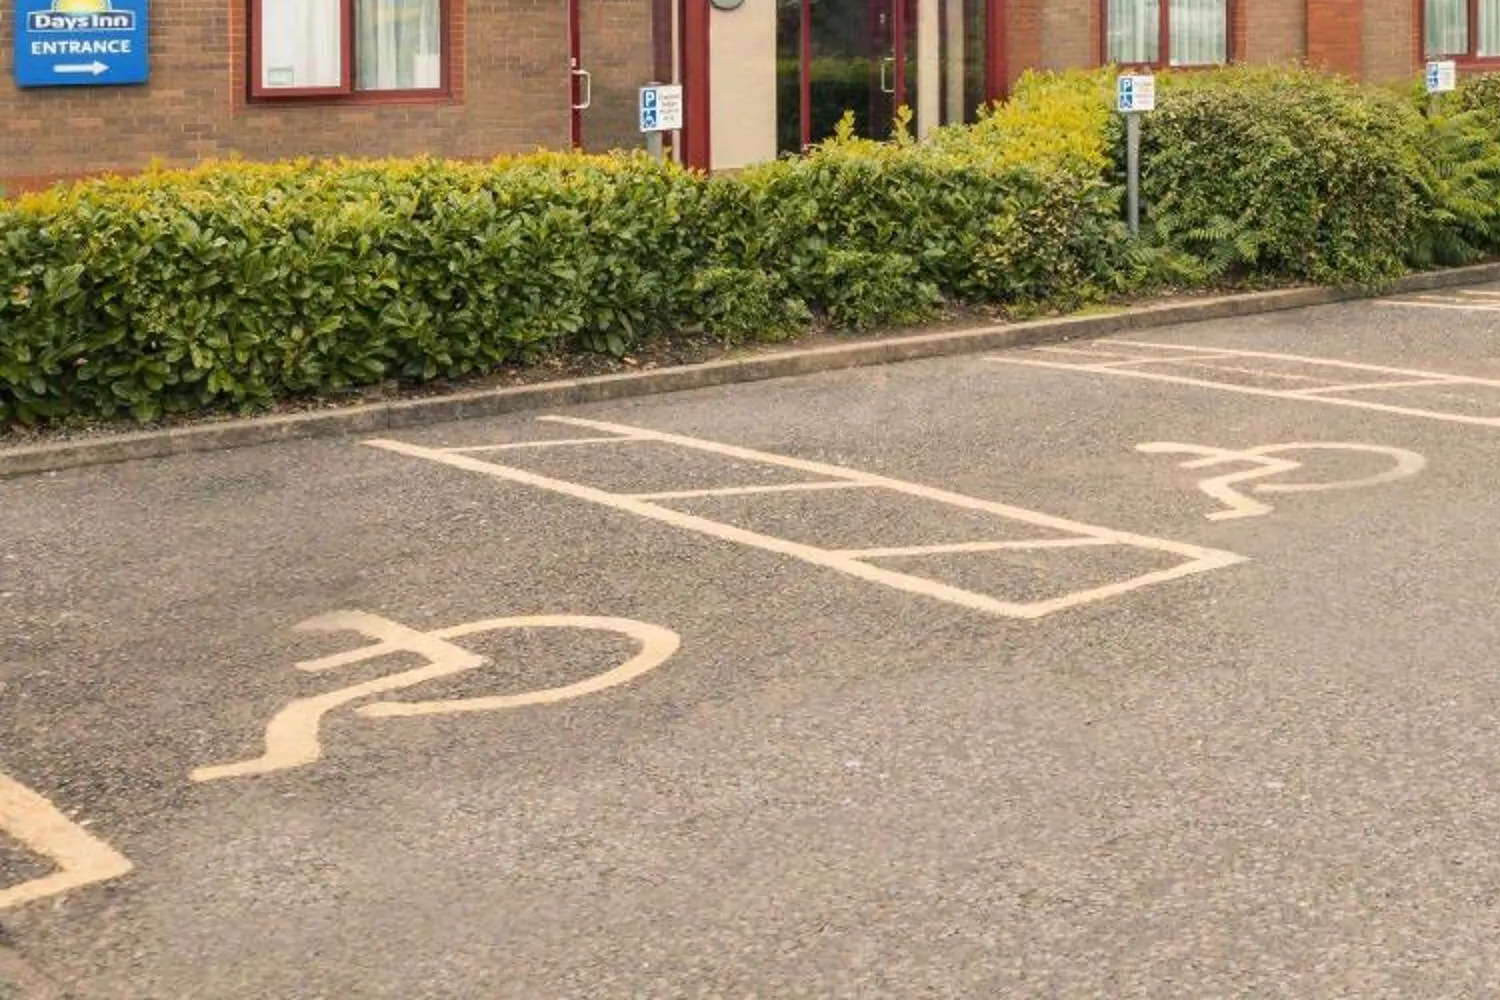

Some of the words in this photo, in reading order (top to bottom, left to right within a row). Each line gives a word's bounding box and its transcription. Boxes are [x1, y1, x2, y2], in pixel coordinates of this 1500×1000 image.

[35, 14, 88, 30] Days
[92, 14, 129, 28] Inn
[31, 39, 132, 55] ENTRANCE
[645, 91, 655, 107] P
